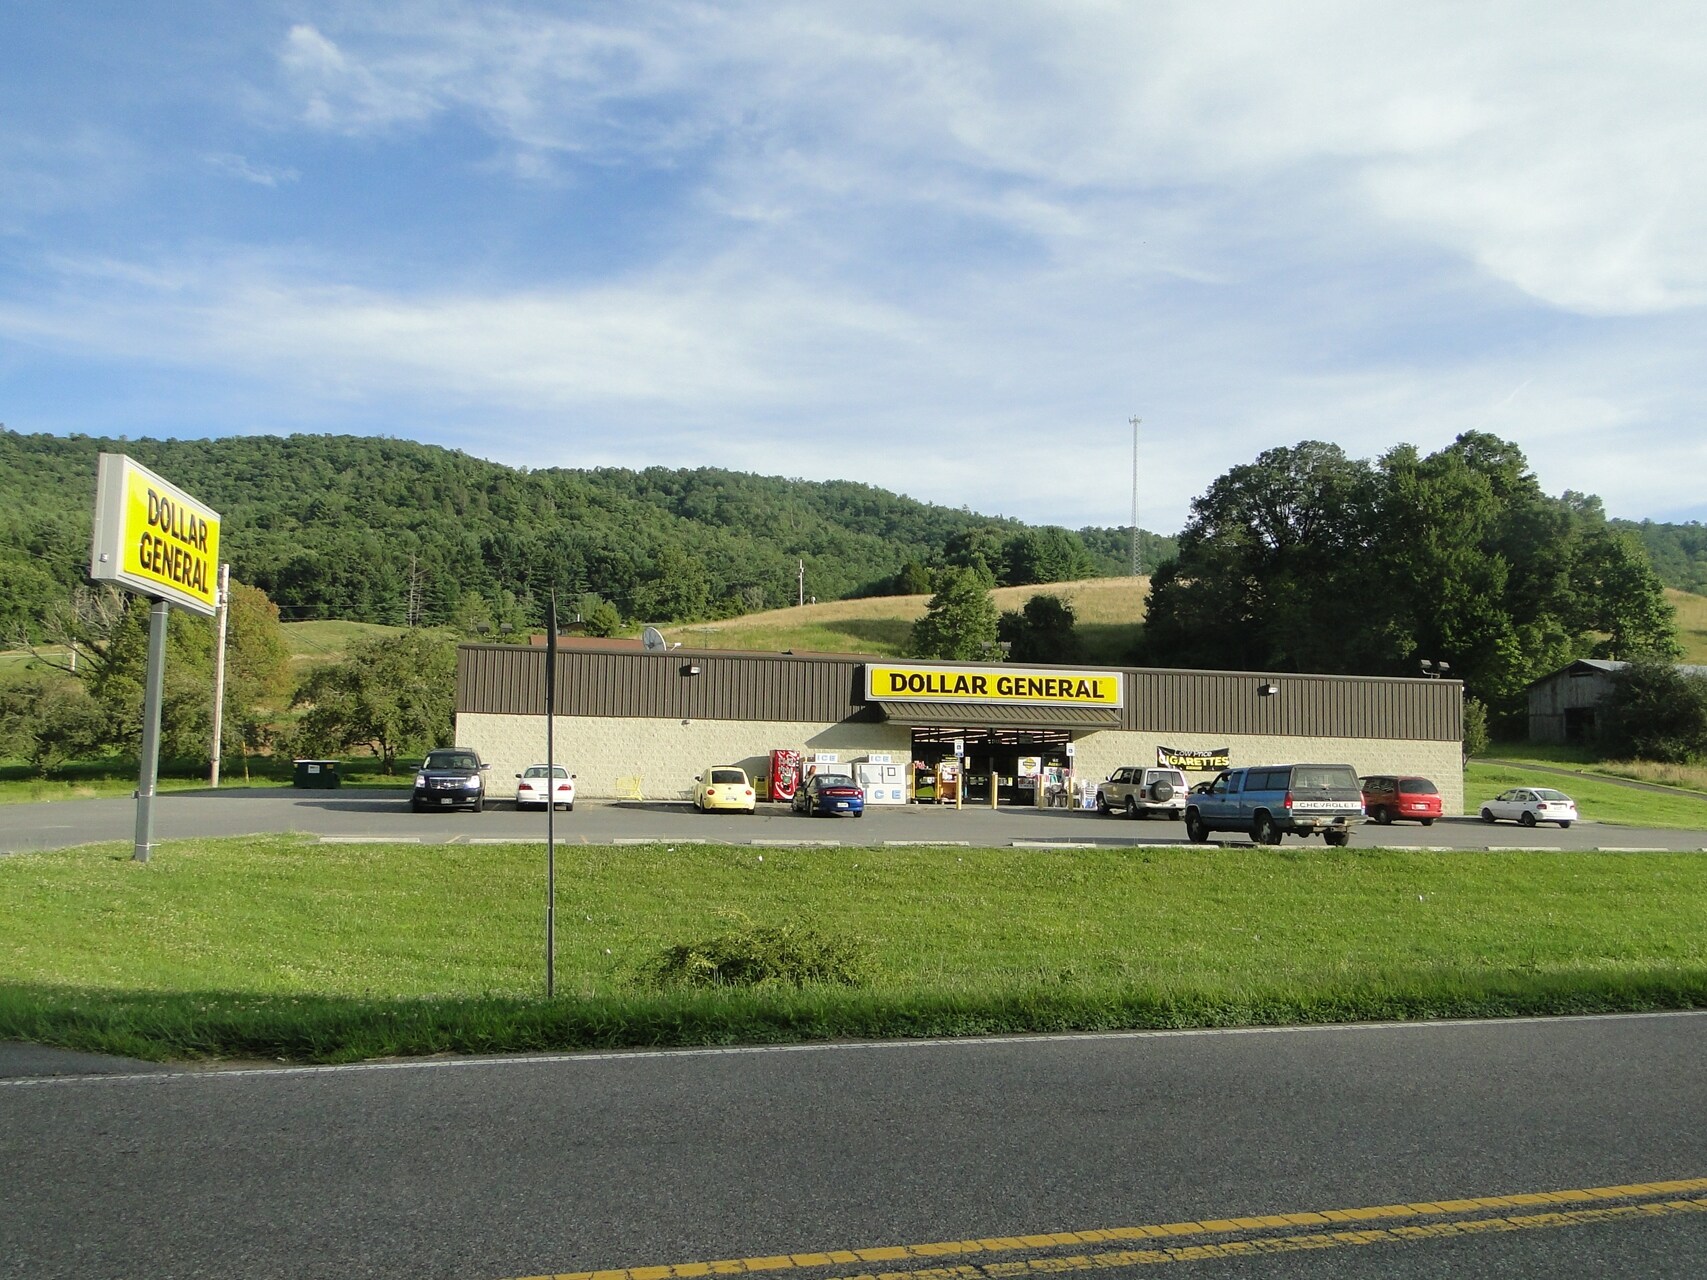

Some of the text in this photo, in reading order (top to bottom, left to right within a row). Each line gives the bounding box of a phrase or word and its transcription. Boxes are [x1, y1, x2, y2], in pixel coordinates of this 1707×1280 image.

[148, 488, 208, 554] DOLLAR
[140, 531, 209, 594] GENERAL
[889, 673, 1105, 699] DOLLAR GENERAL
[1159, 755, 1230, 767] CIGARETTES
